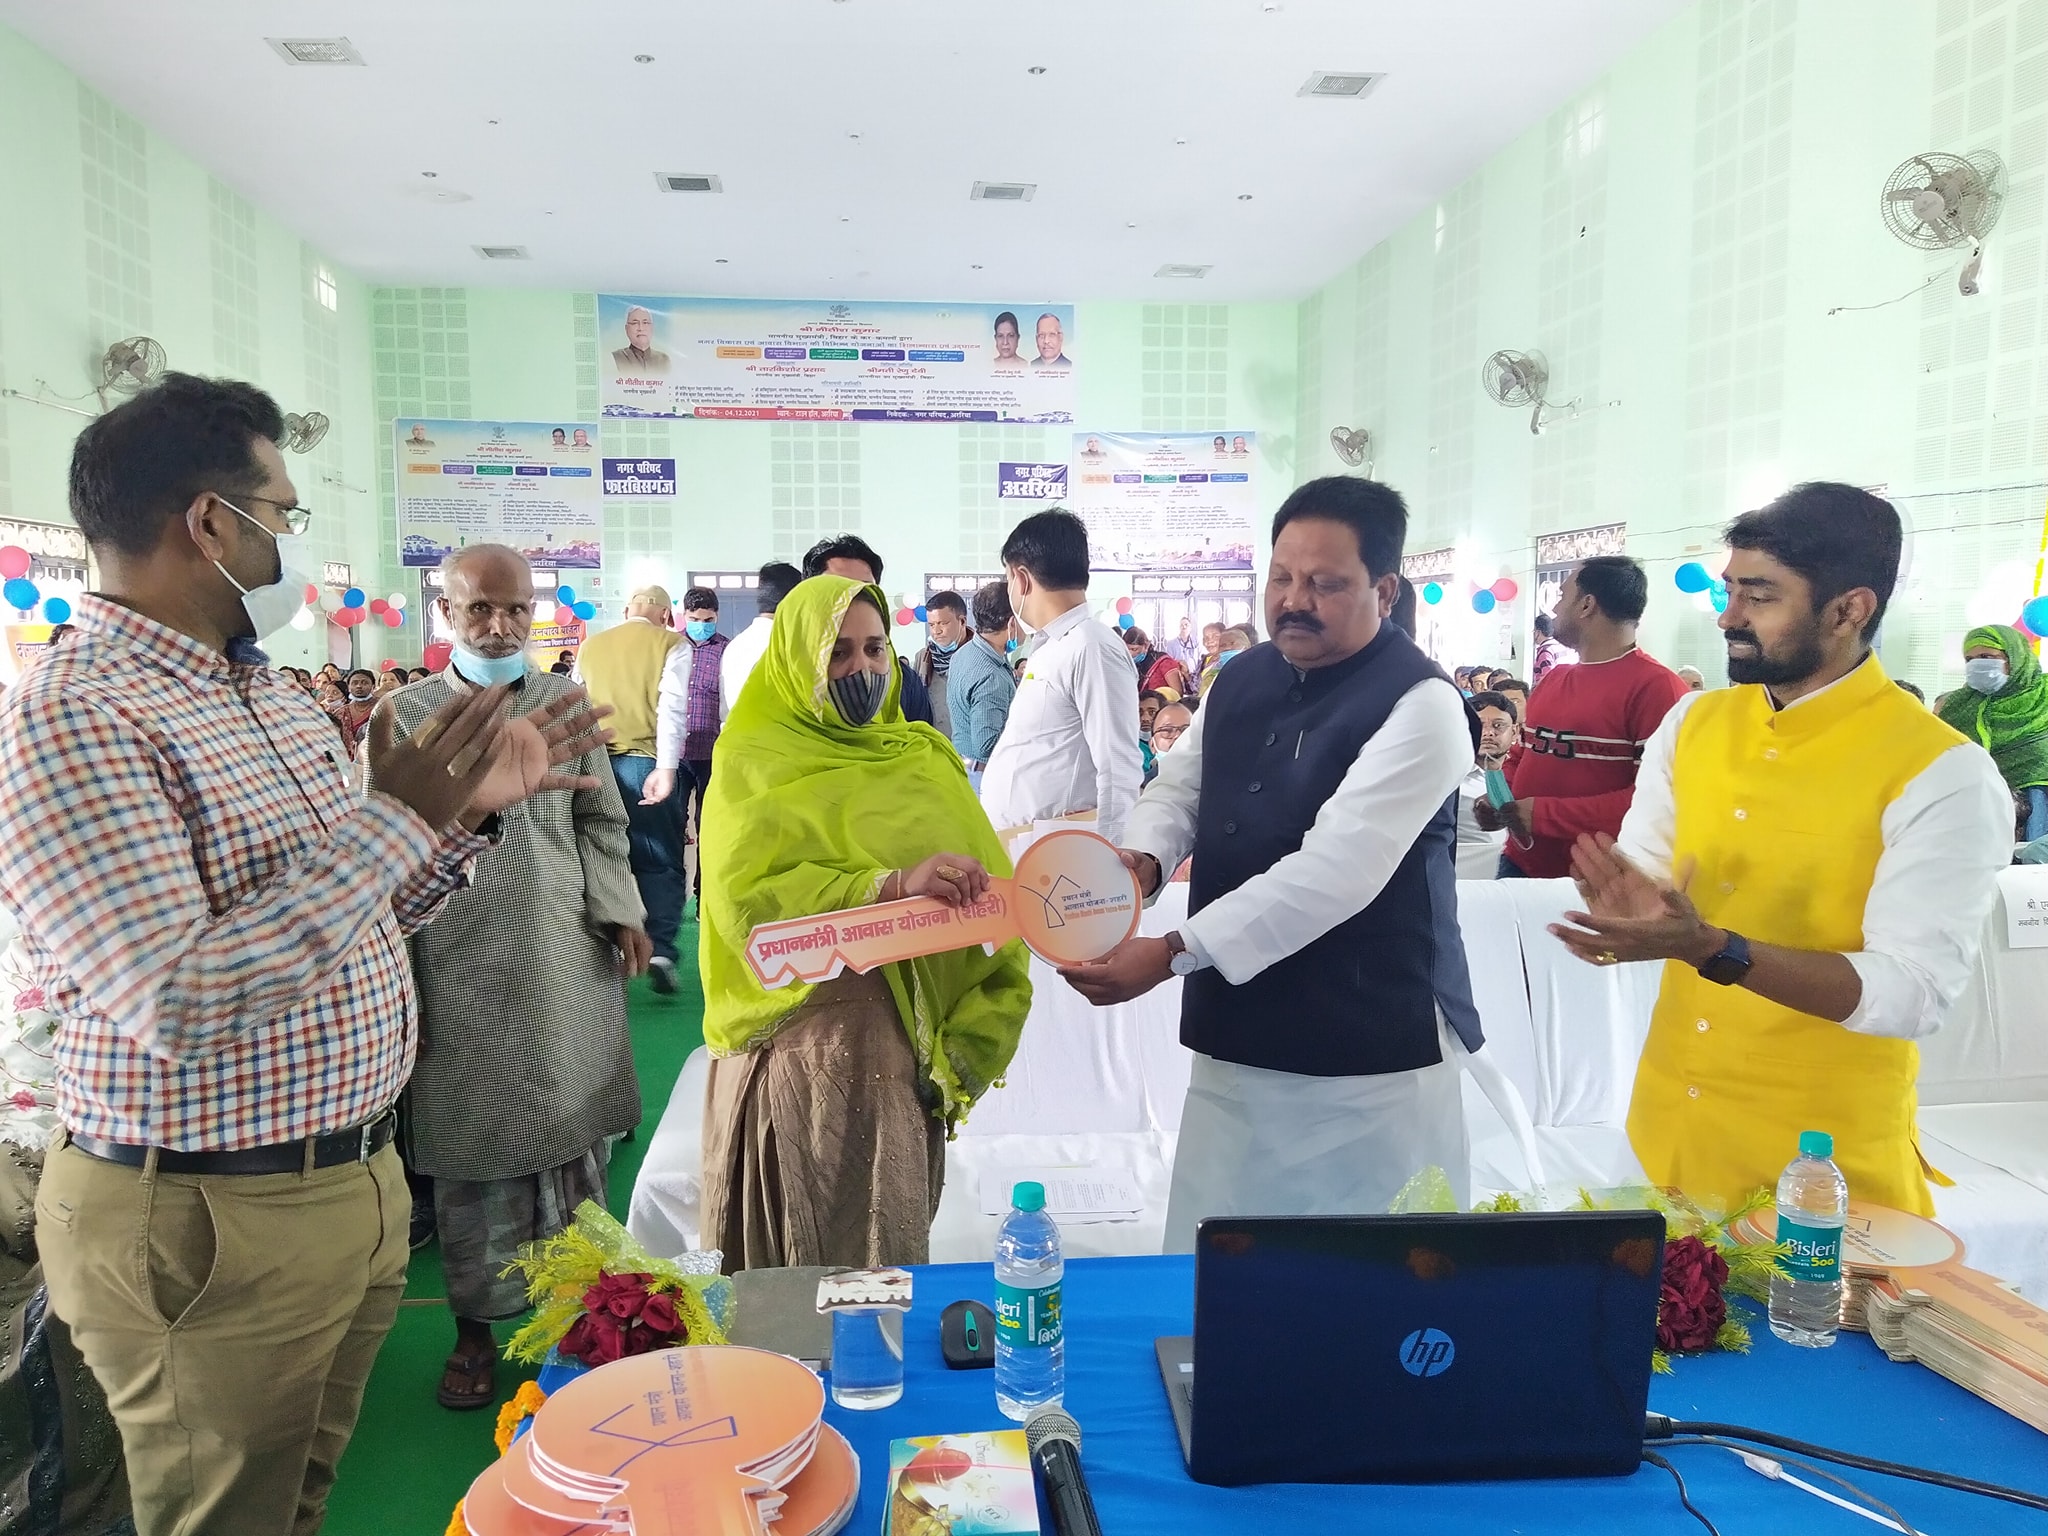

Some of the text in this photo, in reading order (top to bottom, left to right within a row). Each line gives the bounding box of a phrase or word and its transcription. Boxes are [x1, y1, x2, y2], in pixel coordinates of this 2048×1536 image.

[615, 377, 624, 385] श्री
[646, 378, 664, 389] कुमार
[725, 409, 760, 417] 04.12.2021
[915, 411, 928, 419] नगर
[951, 411, 972, 420] अररिया
[615, 460, 663, 474] नगर परिषद
[1014, 467, 1030, 479] नगर
[1002, 478, 1067, 498] अररिया
[1061, 889, 1092, 902] प्रधान मंत्री
[1064, 901, 1085, 912] आवास
[2027, 898, 2036, 910] श्री
[757, 923, 839, 962] प्रधानमंत्री
[841, 918, 895, 944] आवास
[897, 908, 951, 932] योजना
[1786, 1238, 1836, 1257] Bisleri
[1810, 1257, 1835, 1268] 500
[1406, 1328, 1450, 1377] hp
